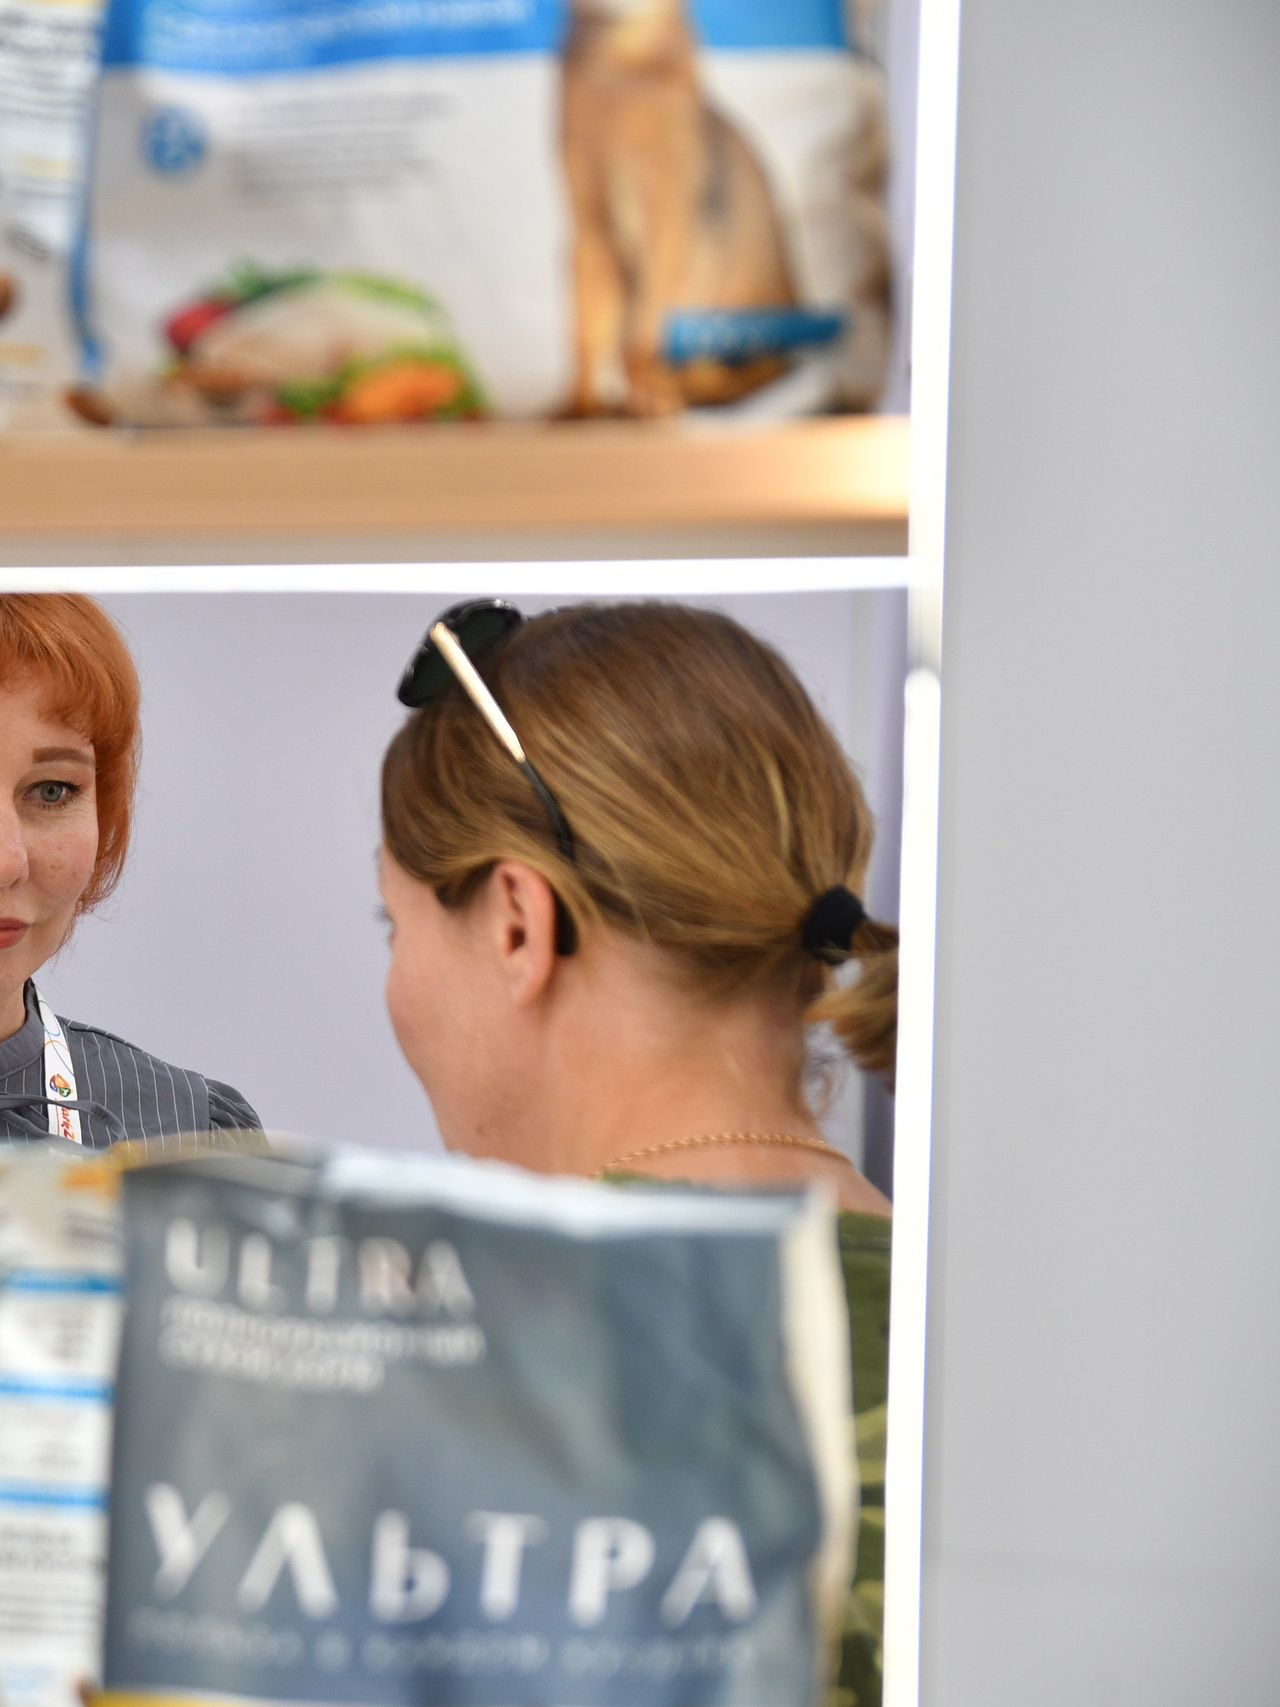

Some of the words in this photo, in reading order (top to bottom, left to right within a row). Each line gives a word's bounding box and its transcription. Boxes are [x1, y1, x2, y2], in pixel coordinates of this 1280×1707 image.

[61, 1106, 76, 1140] arkZ
[164, 1216, 477, 1317] ULTRA
[145, 1482, 758, 1628] УЛЬТРА
